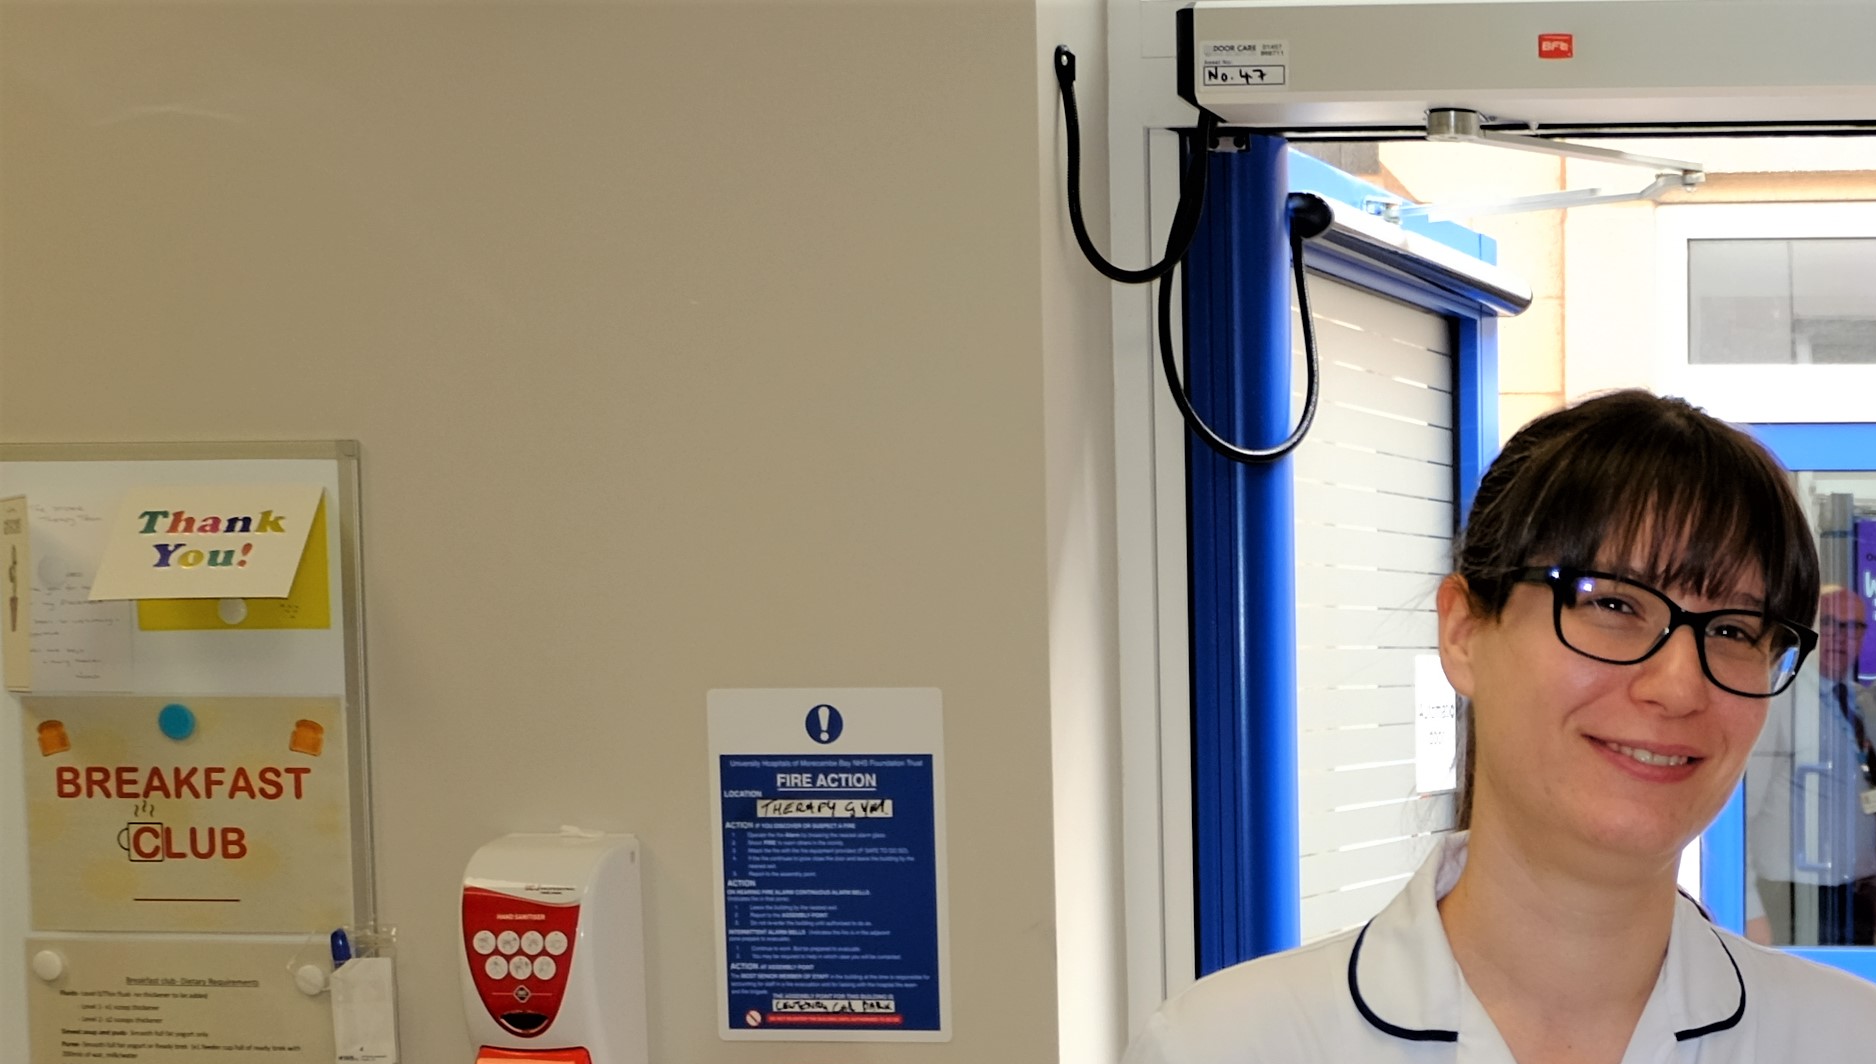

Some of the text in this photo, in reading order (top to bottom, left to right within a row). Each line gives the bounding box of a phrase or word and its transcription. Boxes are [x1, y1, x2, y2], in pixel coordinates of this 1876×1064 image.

[1208, 66, 1266, 85] No. 47
[138, 510, 286, 534] Thank
[152, 542, 254, 569] You!
[56, 766, 311, 799] BREAKFAST
[776, 773, 877, 787] FIRE ACTION
[724, 790, 762, 798] LOCATION
[132, 826, 248, 860] CLUB
